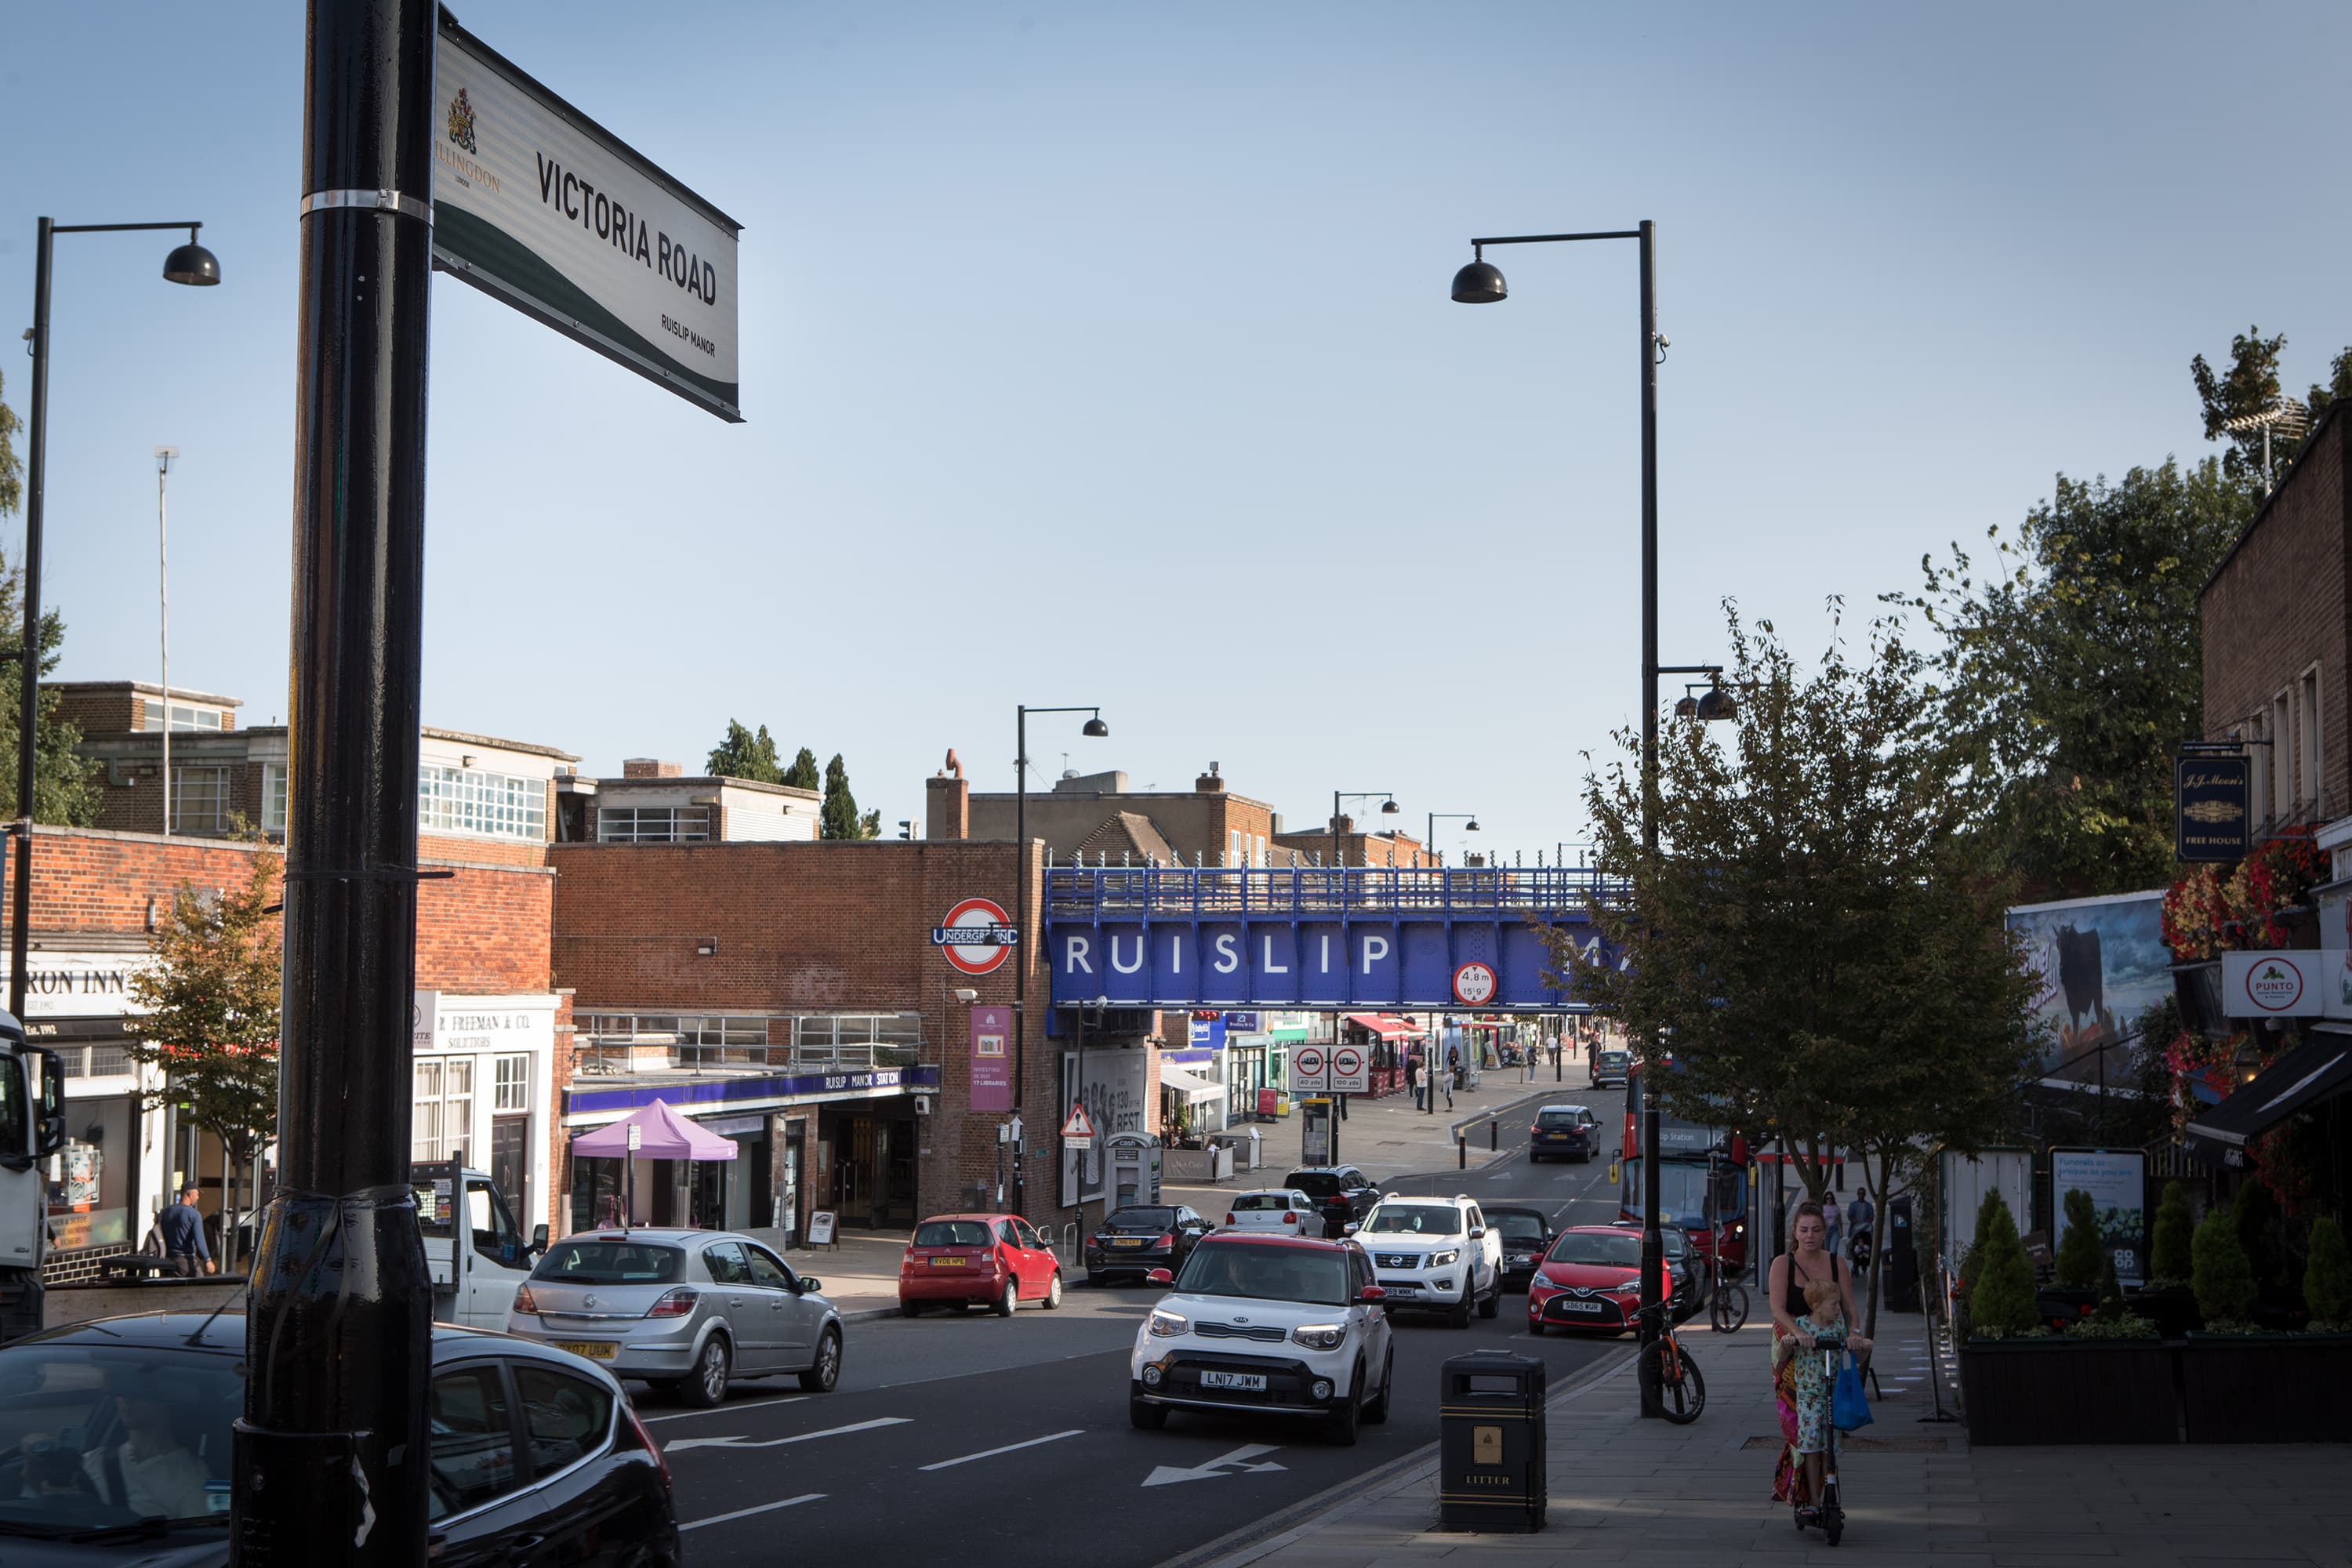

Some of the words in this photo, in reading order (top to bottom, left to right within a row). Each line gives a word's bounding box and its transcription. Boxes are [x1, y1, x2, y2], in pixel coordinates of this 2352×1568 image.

[434, 140, 500, 194] ILLINGDON
[536, 151, 652, 269] VICTORIA
[658, 230, 716, 307] ROAD
[661, 314, 689, 342] RUISLIP
[691, 327, 716, 358] MANOR
[2209, 837, 2241, 845] HOUSE
[933, 928, 1018, 944] UNDERGRND
[1066, 935, 1389, 974] RUISLIP
[25, 971, 74, 994] RON
[82, 971, 125, 994] INN
[1462, 971, 1479, 981] 4.8
[2256, 982, 2294, 990] PUNTO
[452, 1015, 499, 1031] FREEMAN
[826, 1076, 847, 1090] RUISLIP
[851, 1073, 873, 1087] MANOR
[877, 1071, 898, 1085] STATION
[1670, 1131, 1694, 1142] Station
[2058, 1167, 2088, 1176] unique
[1207, 1372, 1234, 1385] LN17
[1237, 1375, 1260, 1388] JWM
[1466, 1475, 1510, 1485] LITTER
